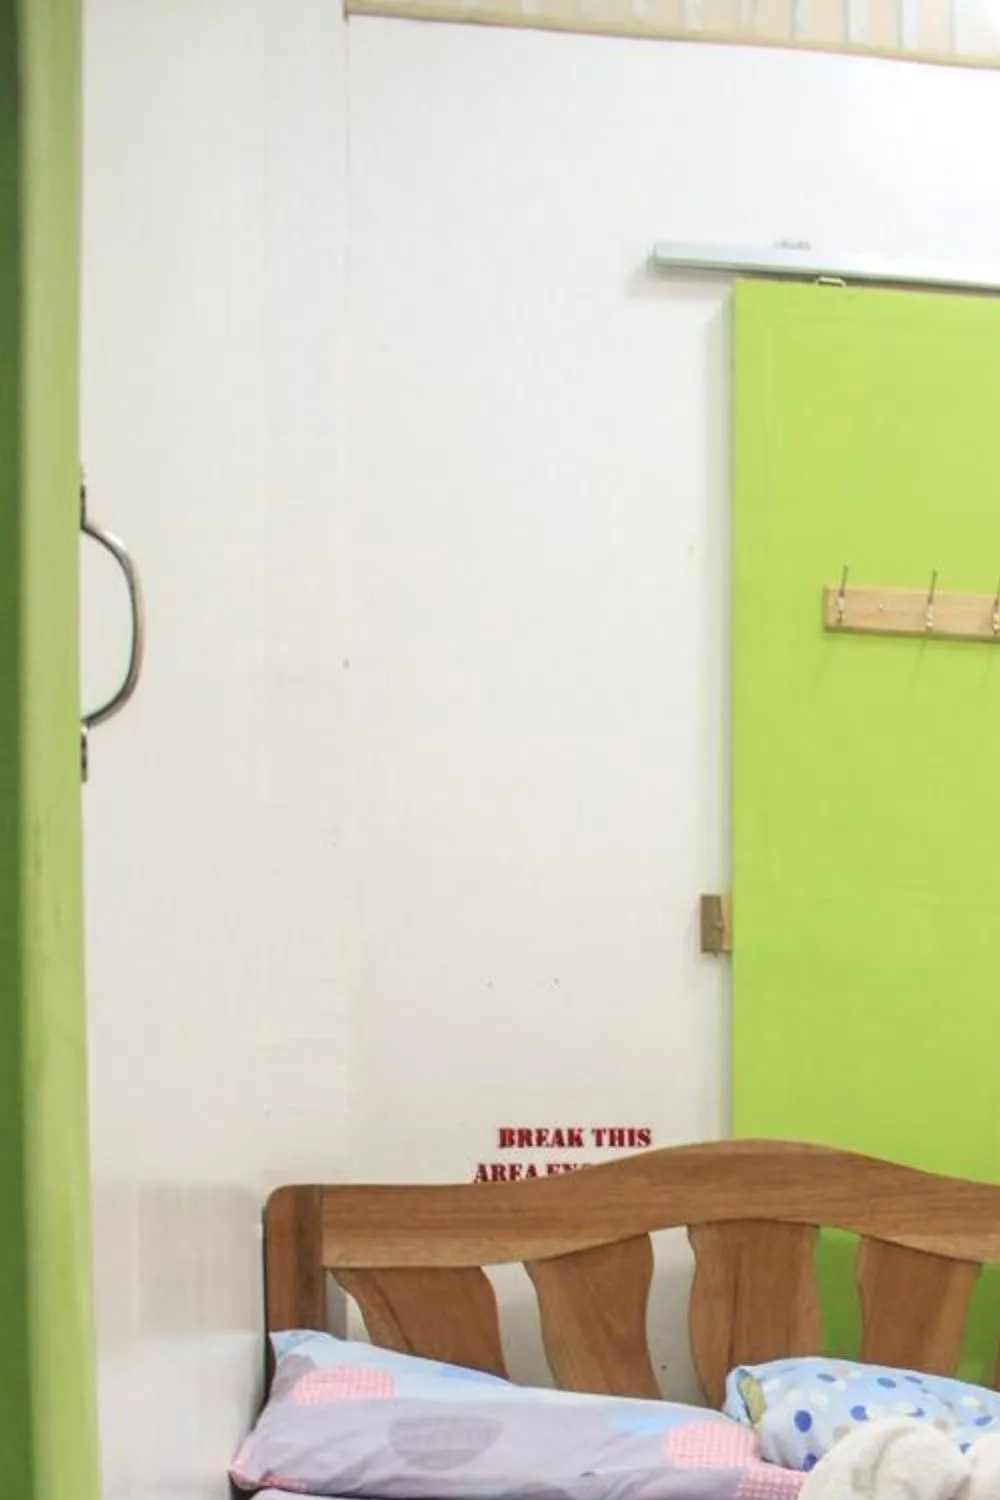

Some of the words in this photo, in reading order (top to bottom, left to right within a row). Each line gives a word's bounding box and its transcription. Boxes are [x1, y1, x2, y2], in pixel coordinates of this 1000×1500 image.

[498, 1127, 584, 1148] BREAK
[591, 1127, 651, 1148] THIS
[474, 1163, 537, 1183] AREA
